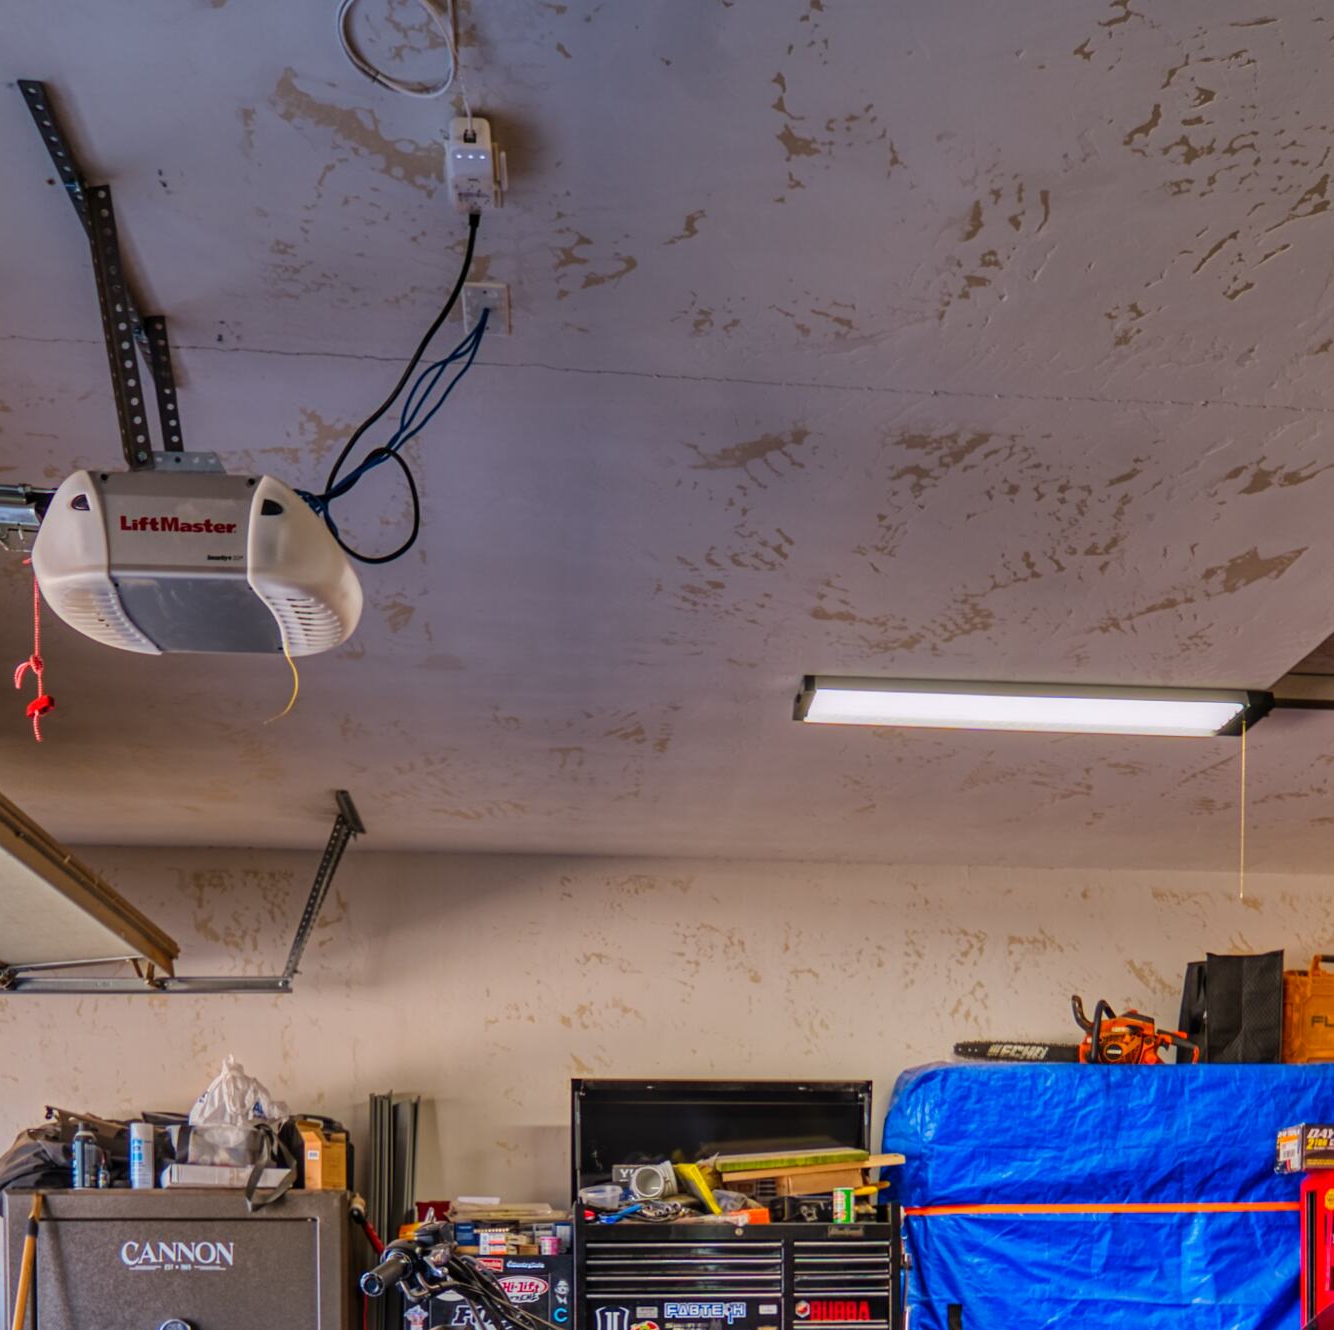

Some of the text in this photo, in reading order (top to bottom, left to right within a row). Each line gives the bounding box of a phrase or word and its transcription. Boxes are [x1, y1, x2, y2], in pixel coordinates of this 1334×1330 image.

[120, 515, 236, 534] LiftMaster
[998, 1044, 1049, 1060] ECHO
[121, 1241, 234, 1266] CANNON
[664, 1303, 747, 1325] FABTECH
